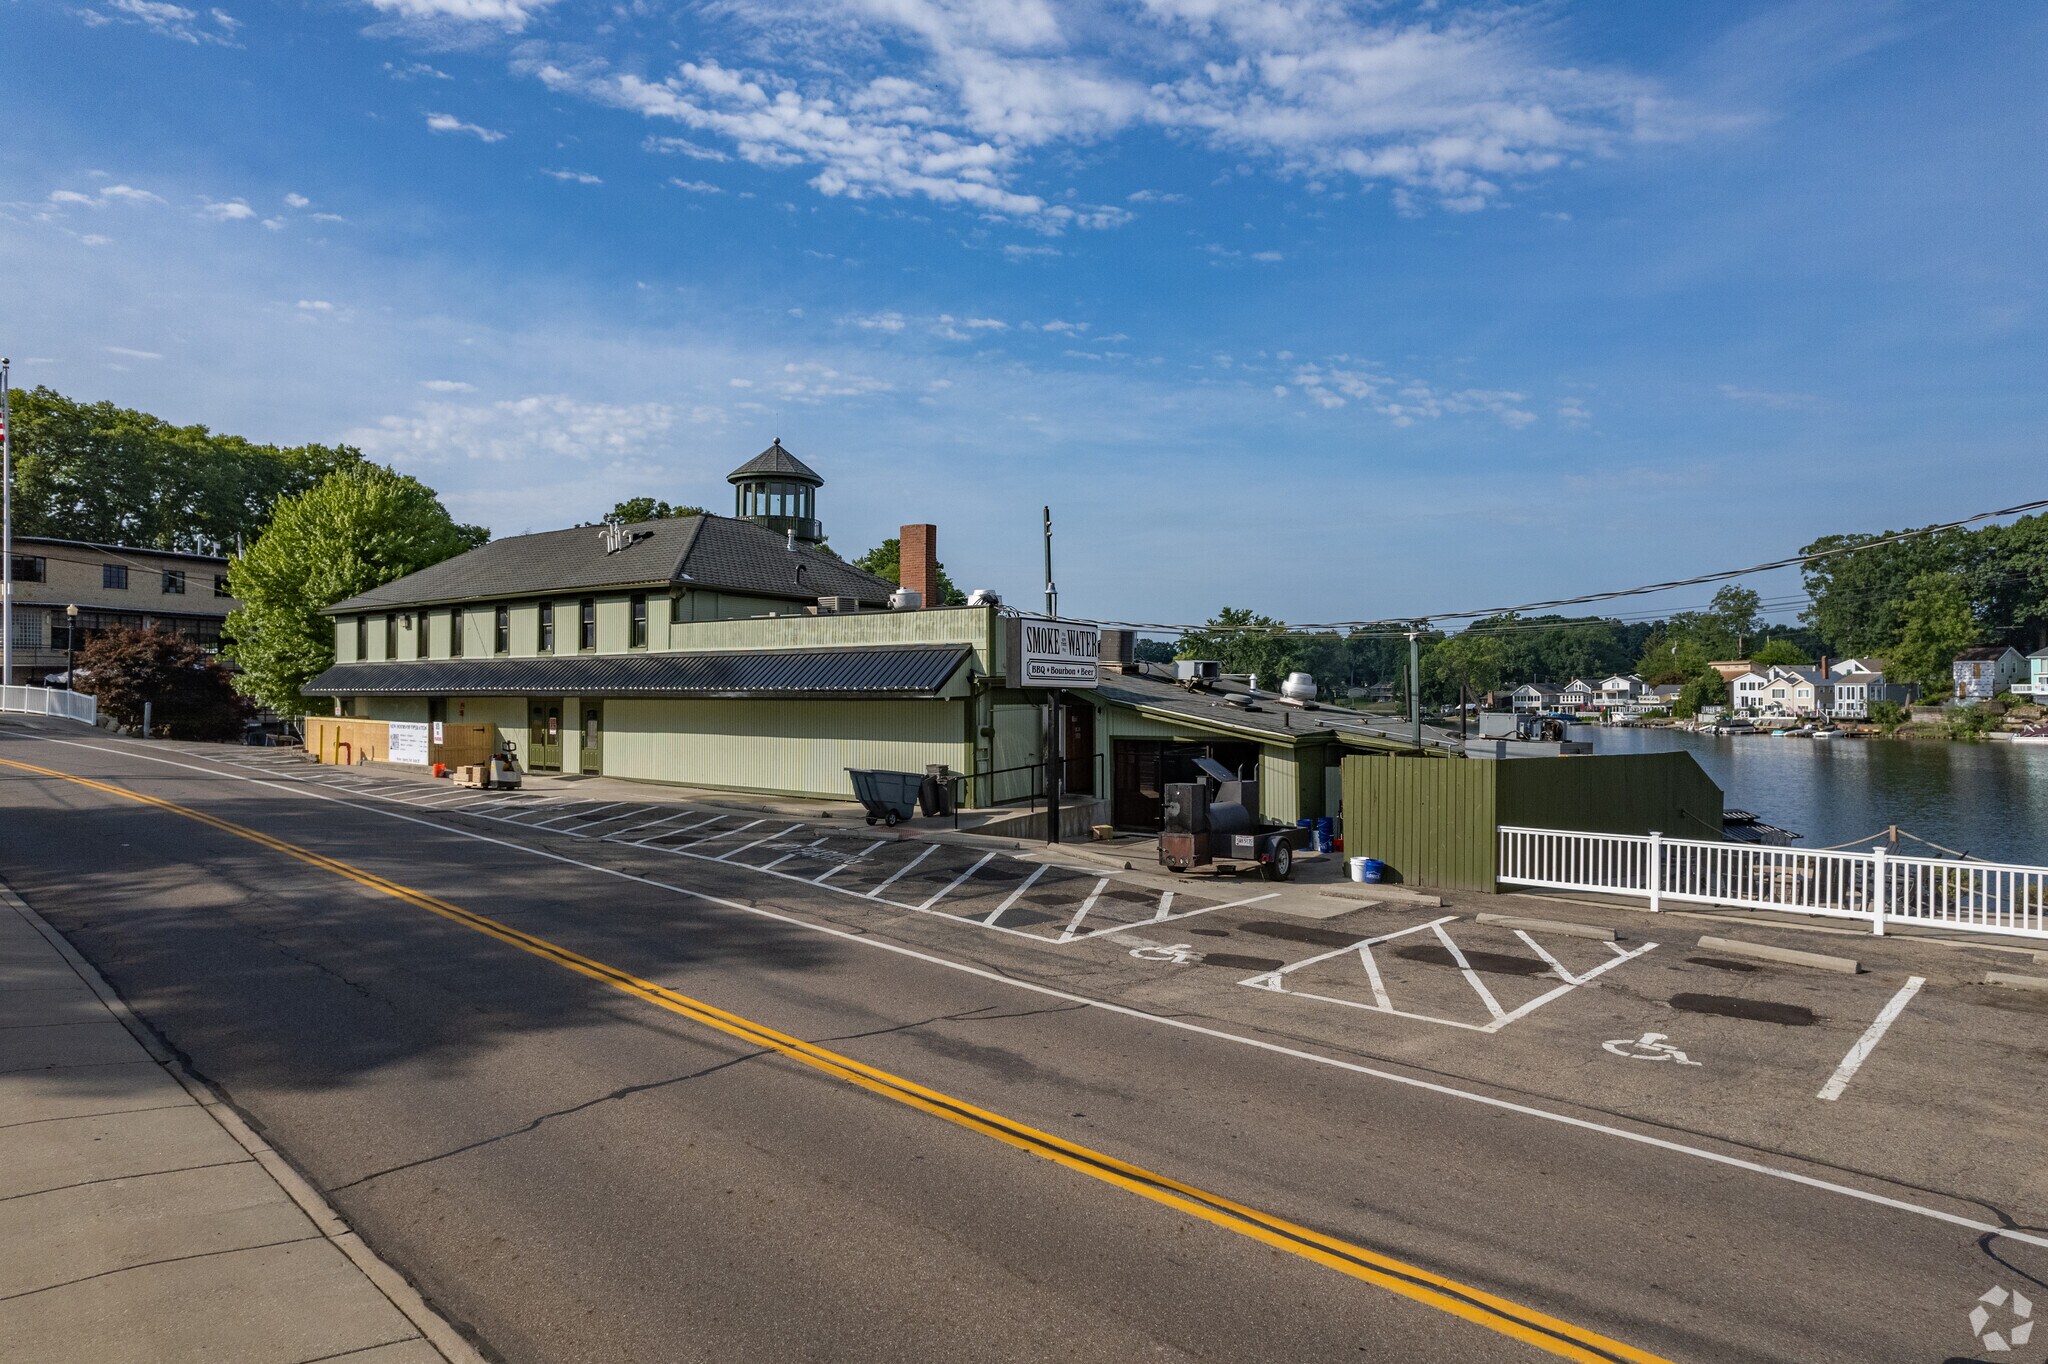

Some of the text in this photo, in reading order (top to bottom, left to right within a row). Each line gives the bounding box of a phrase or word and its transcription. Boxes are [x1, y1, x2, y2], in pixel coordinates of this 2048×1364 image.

[1027, 627, 1060, 654] SMOKE
[1067, 630, 1097, 657] WATER
[1032, 666, 1045, 675] BBQ
[1051, 667, 1075, 675] Bourbon
